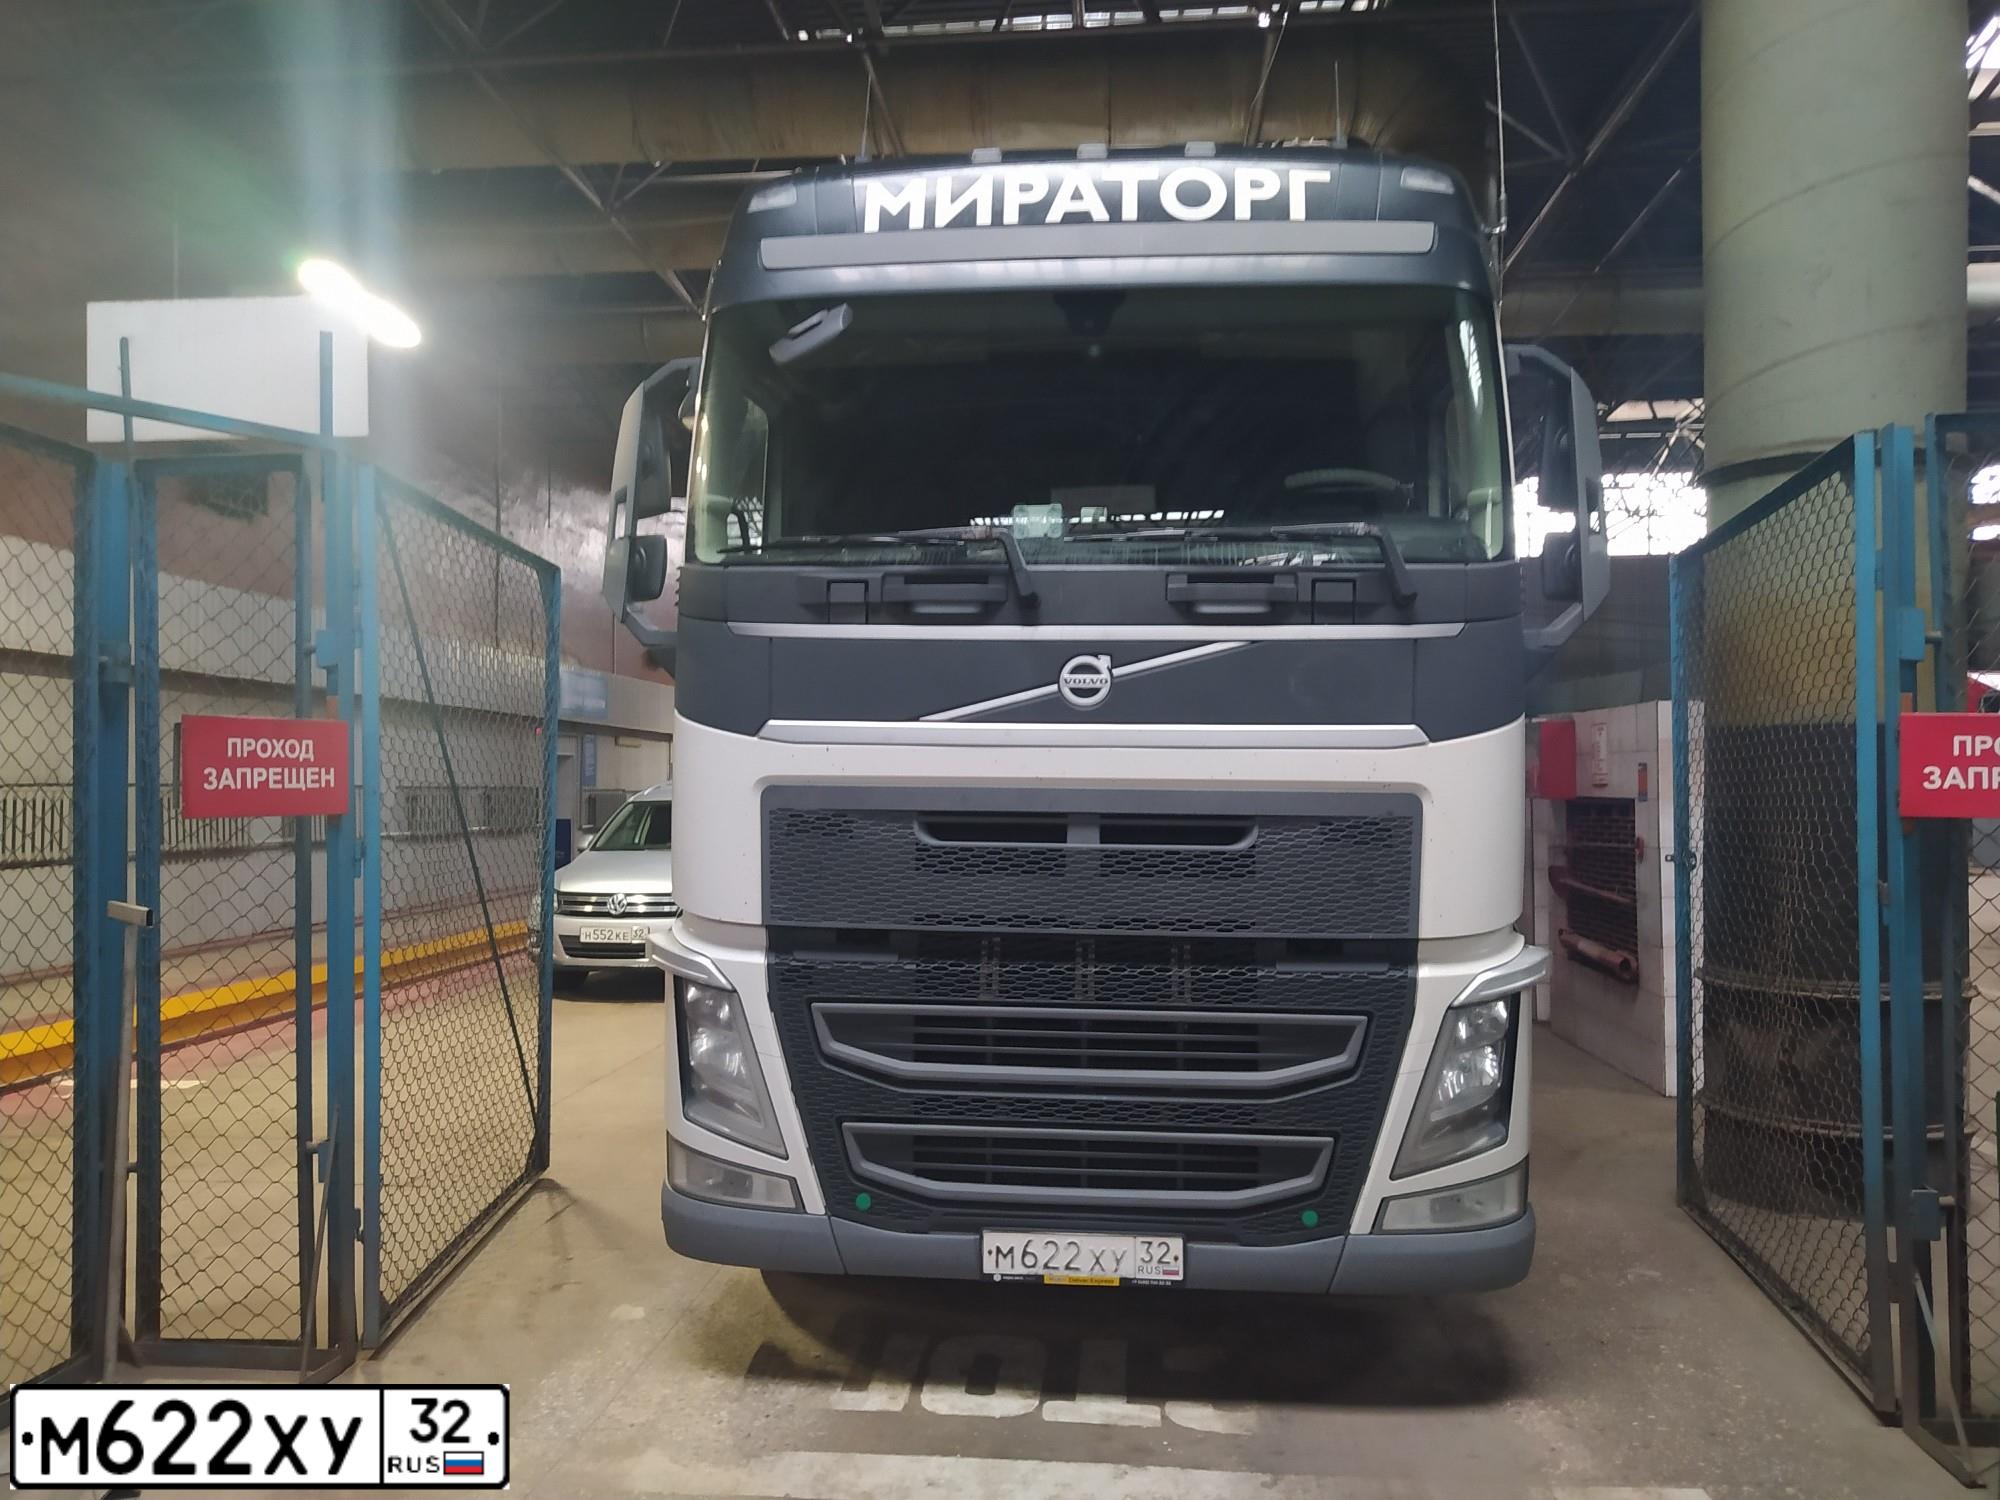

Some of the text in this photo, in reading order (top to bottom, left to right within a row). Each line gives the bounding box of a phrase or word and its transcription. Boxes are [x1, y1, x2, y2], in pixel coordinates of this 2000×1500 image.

[864, 166, 1331, 234] МИРАТОРГ
[227, 738, 314, 762] ПРОХОД
[1953, 735, 2000, 757] ПР
[203, 767, 335, 791] ЗАПРЕЩЕН
[995, 1239, 1171, 1273] М622ХУ 32
[1137, 1265, 1161, 1275] RUS
